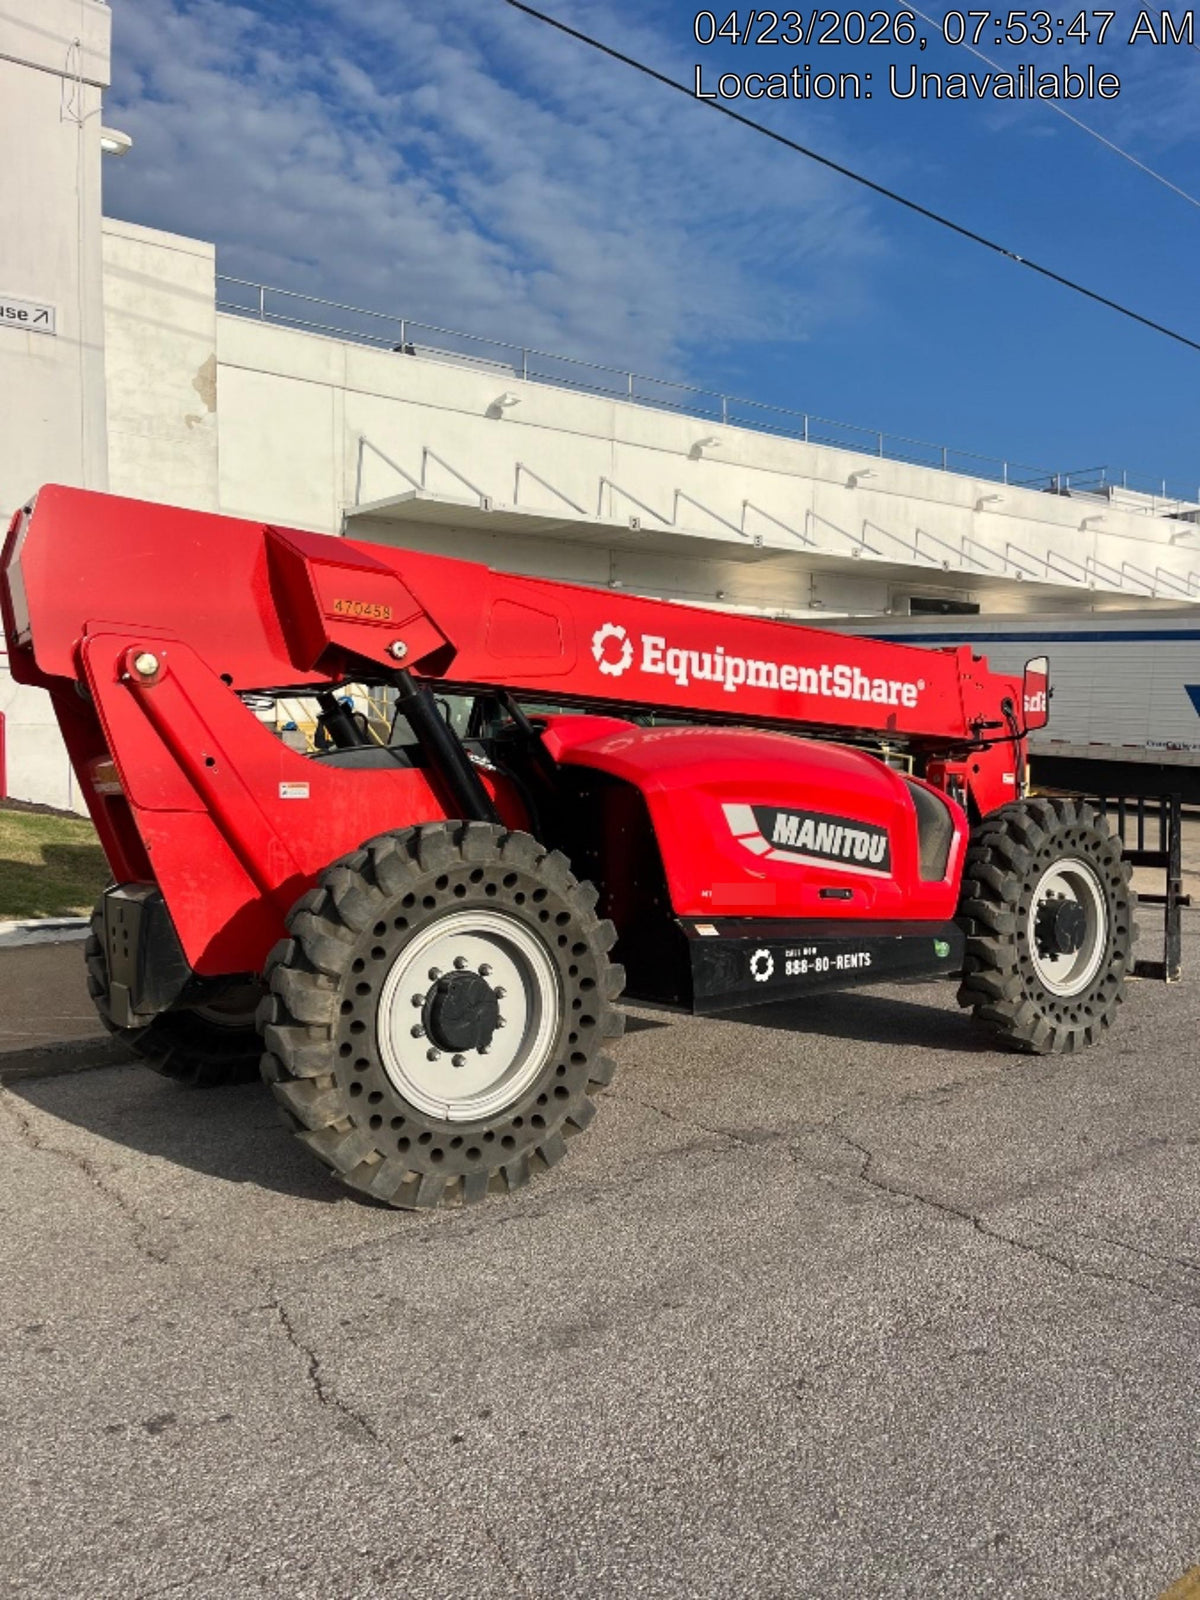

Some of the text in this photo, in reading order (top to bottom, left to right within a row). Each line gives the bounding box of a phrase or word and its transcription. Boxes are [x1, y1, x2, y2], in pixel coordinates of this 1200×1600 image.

[335, 600, 391, 619] 470458
[772, 812, 887, 863] MANITOU
[785, 952, 872, 975] 888-80-RENTS
